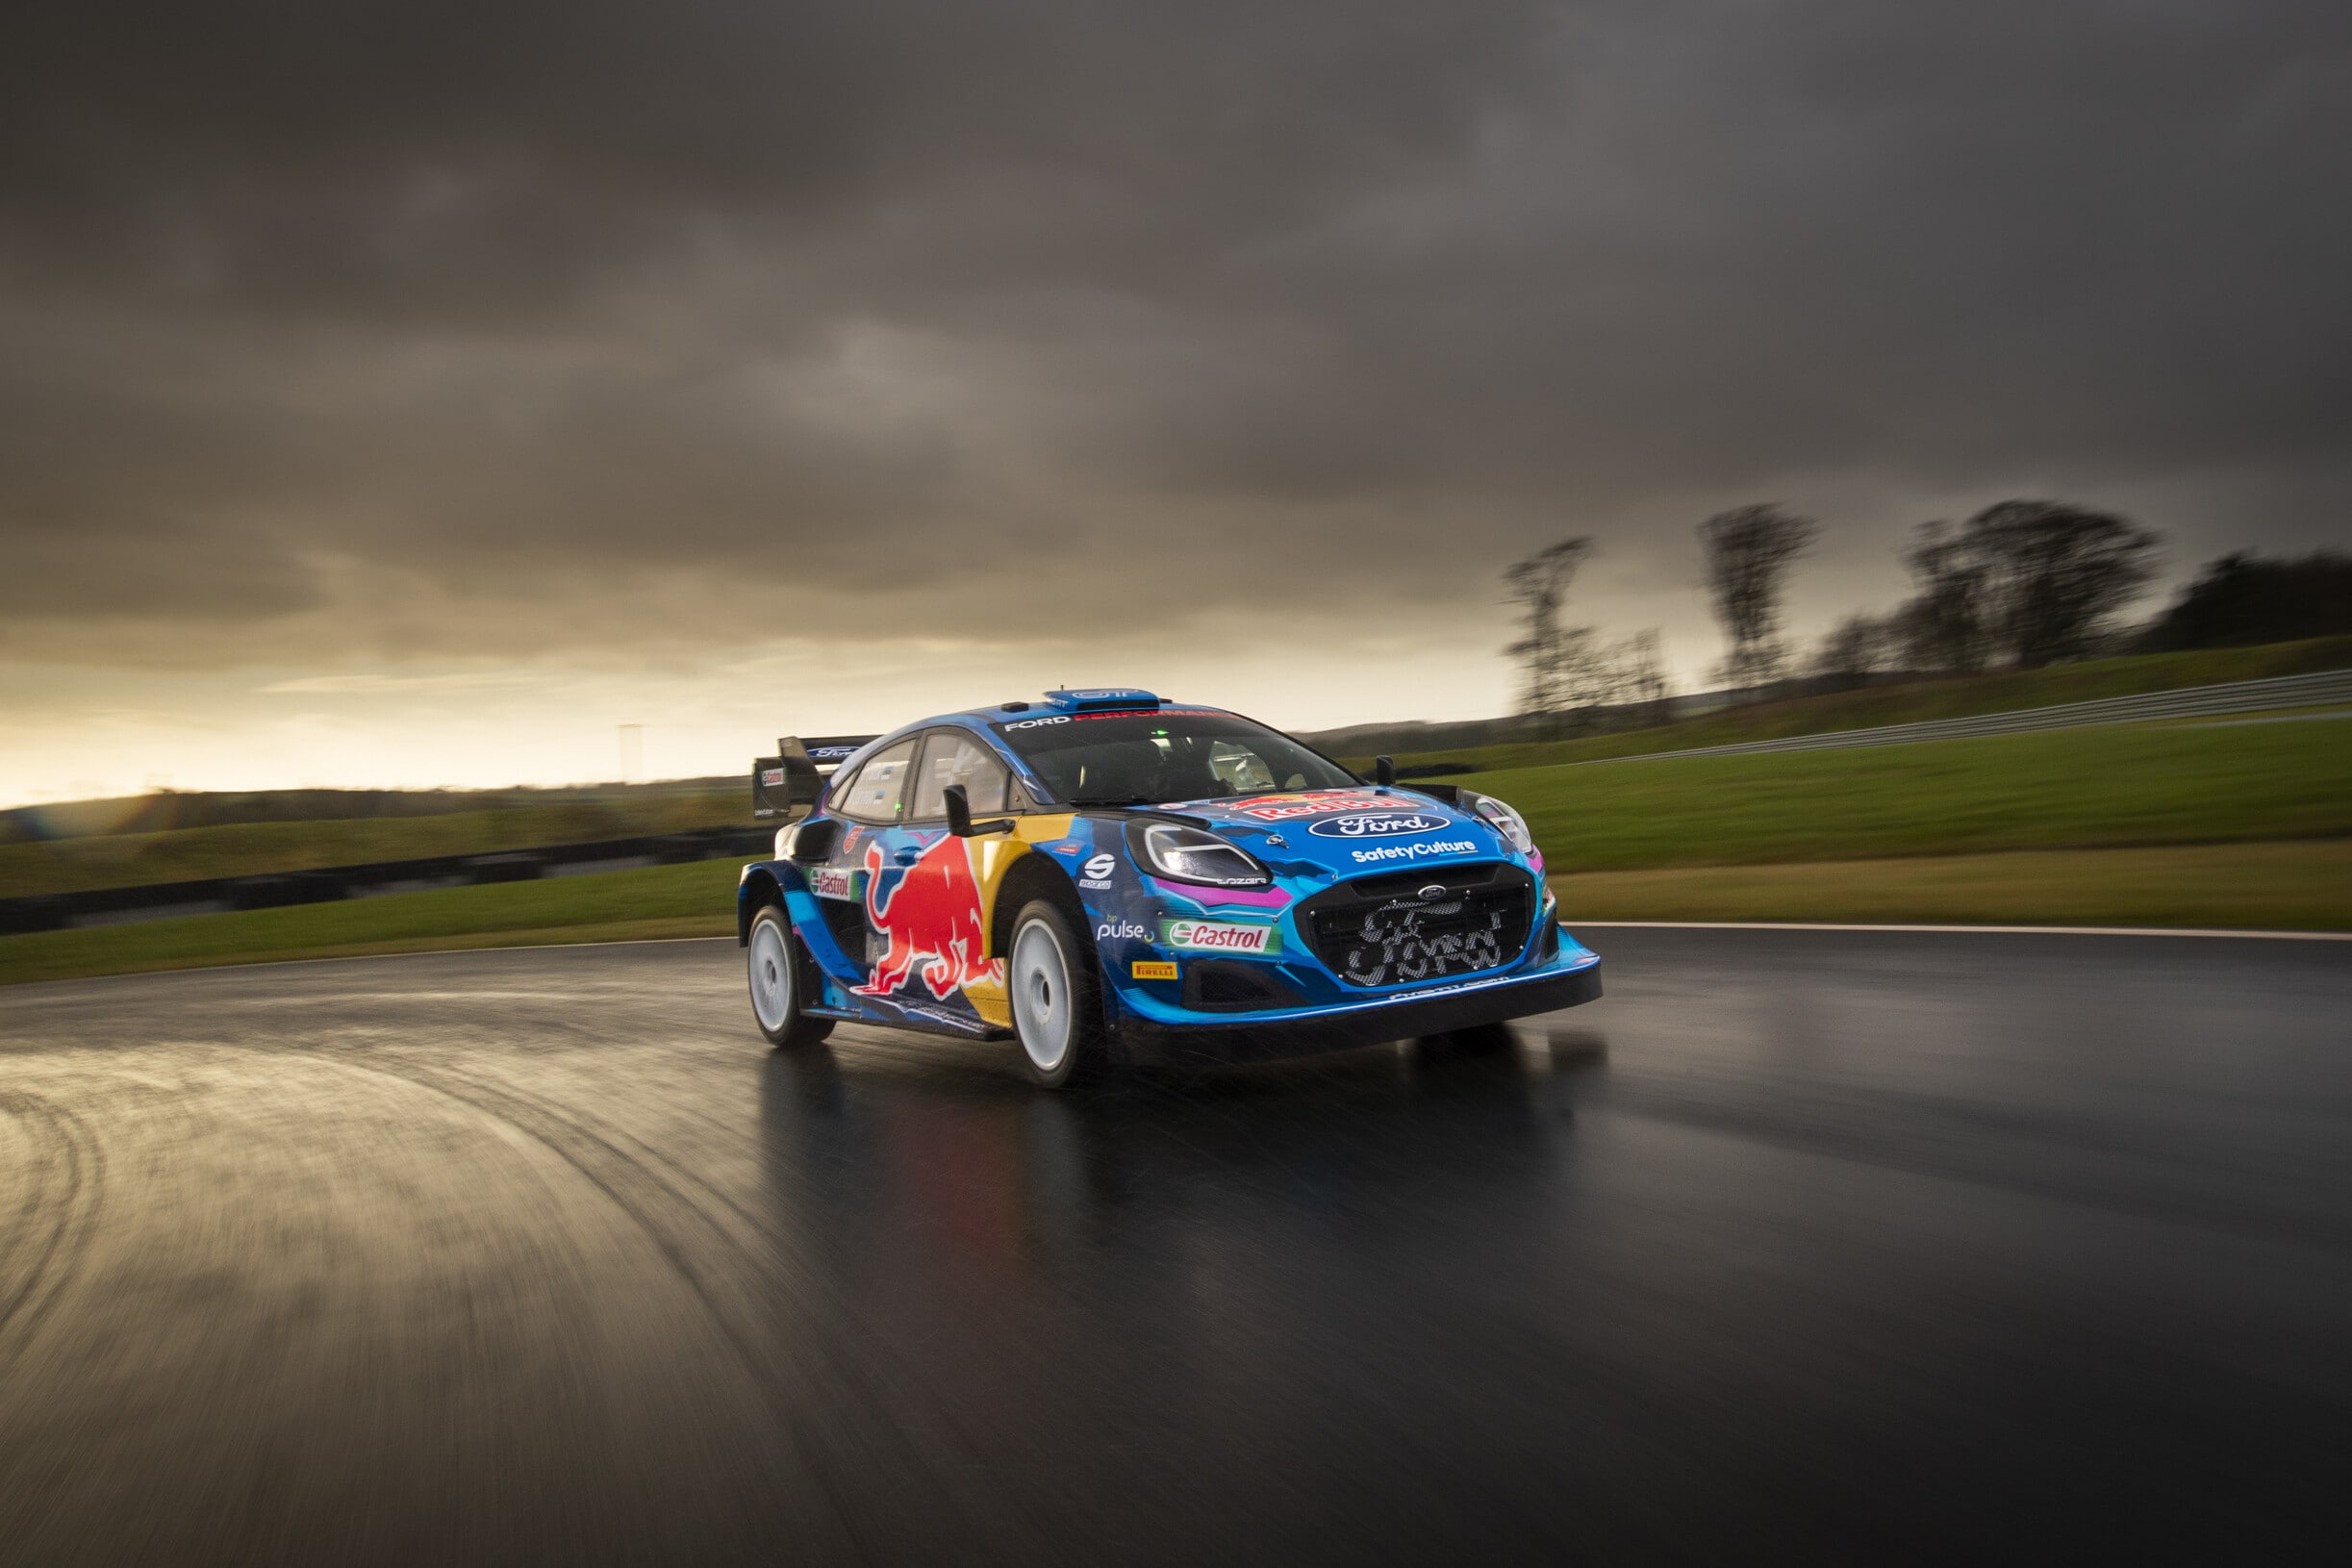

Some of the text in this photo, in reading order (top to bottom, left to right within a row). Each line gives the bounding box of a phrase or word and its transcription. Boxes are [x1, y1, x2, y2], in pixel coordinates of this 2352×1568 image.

[1004, 716, 1072, 731] FORD
[1244, 797, 1421, 821] Red Bull
[1337, 814, 1429, 835] Ford
[1352, 841, 1477, 863] SafetyCulture
[820, 872, 848, 896] Castrol
[1106, 914, 1118, 923] bp
[1097, 920, 1144, 941] pulse
[1192, 925, 1264, 948] Castrol
[1136, 965, 1173, 975] PIRELLI
